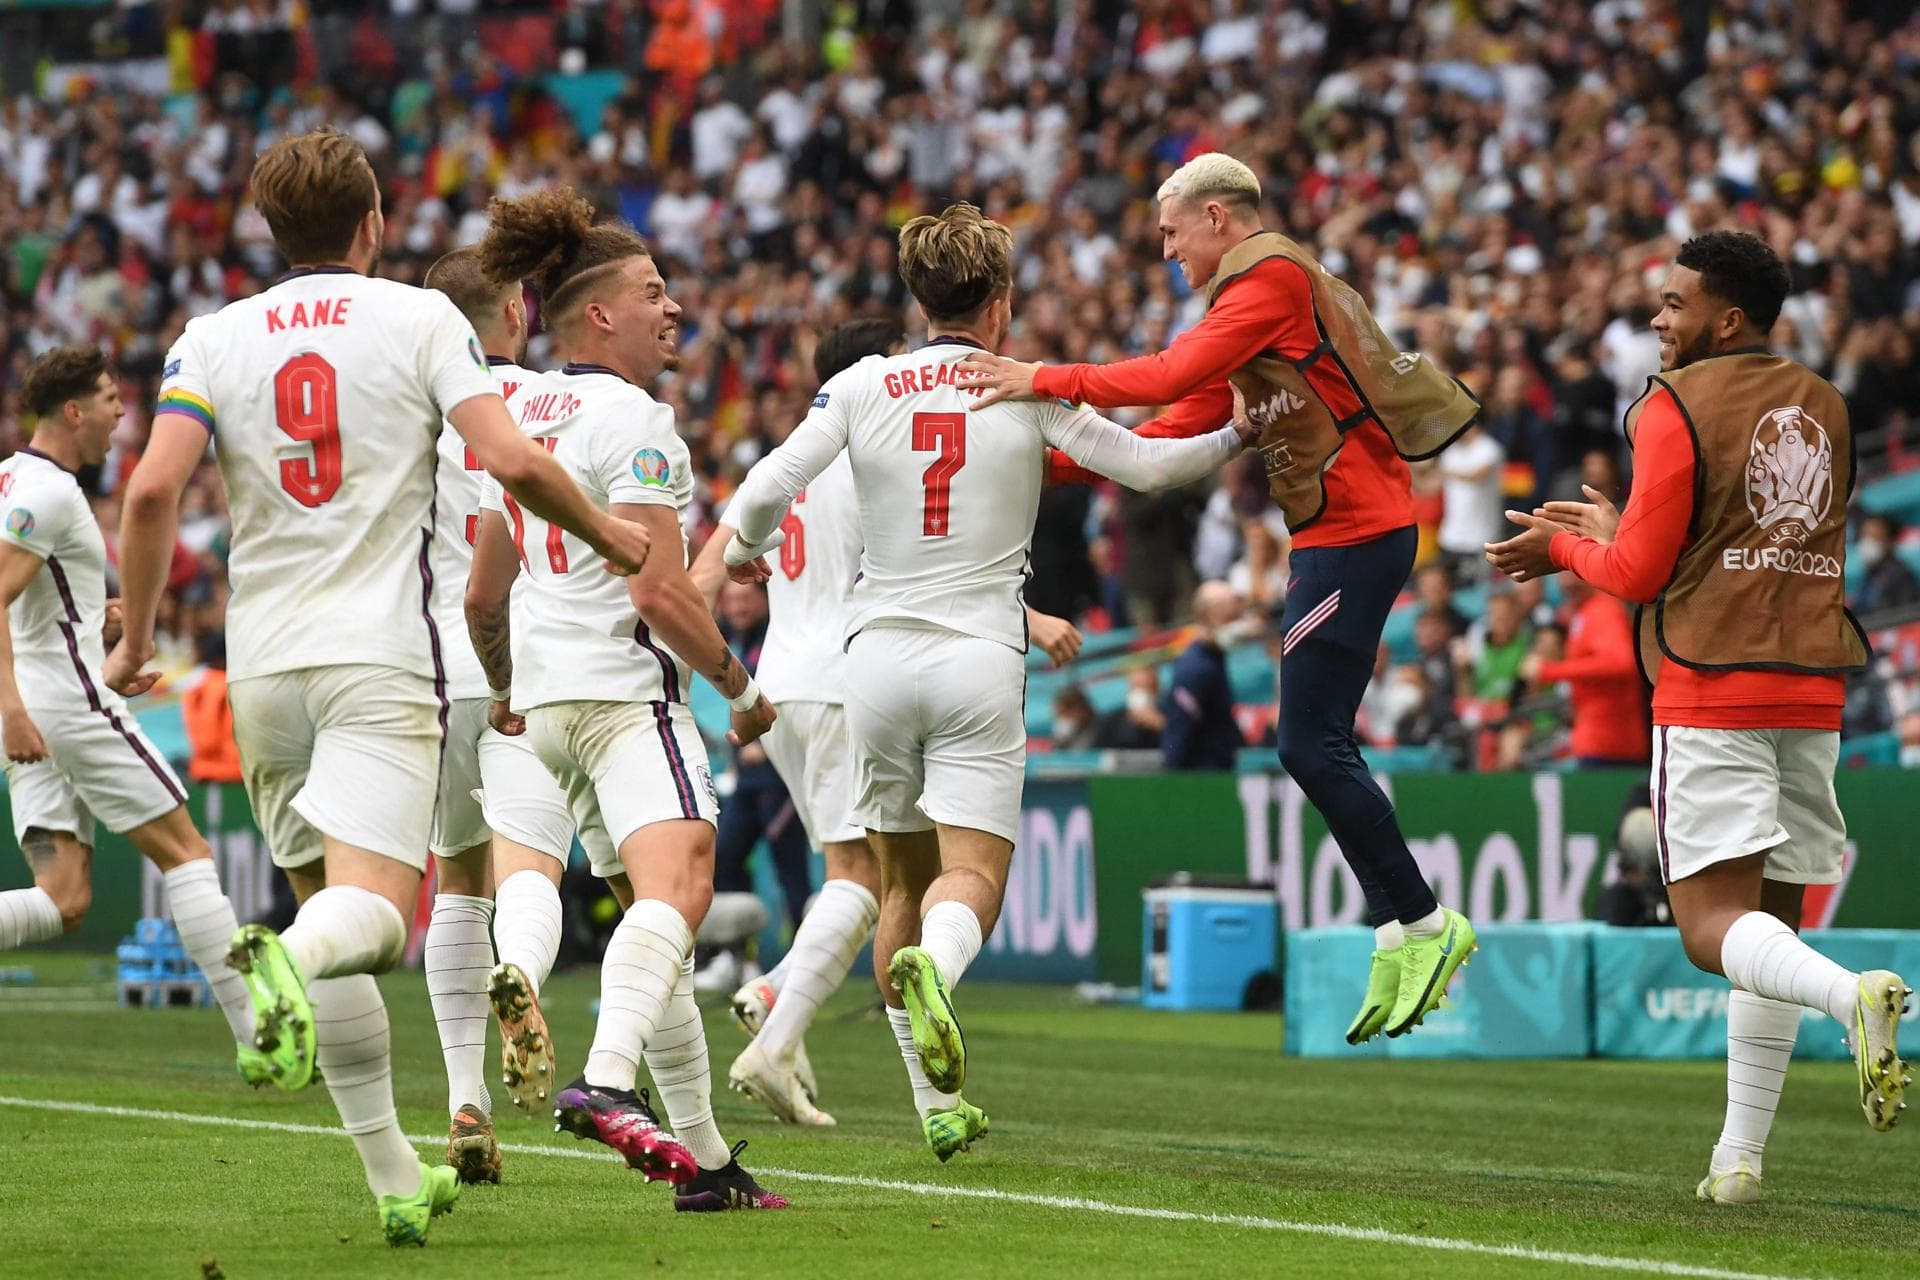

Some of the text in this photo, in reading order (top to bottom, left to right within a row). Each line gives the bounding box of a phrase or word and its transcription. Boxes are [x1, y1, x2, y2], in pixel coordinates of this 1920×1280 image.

[266, 297, 352, 334] KANE
[884, 363, 992, 399] GREA
[519, 391, 581, 426] PHILPS
[274, 351, 342, 508] 9
[911, 412, 966, 537] 7
[1768, 525, 1808, 543] UEFA
[1722, 545, 1842, 578] EURO2020
[1237, 771, 1622, 929] Henek
